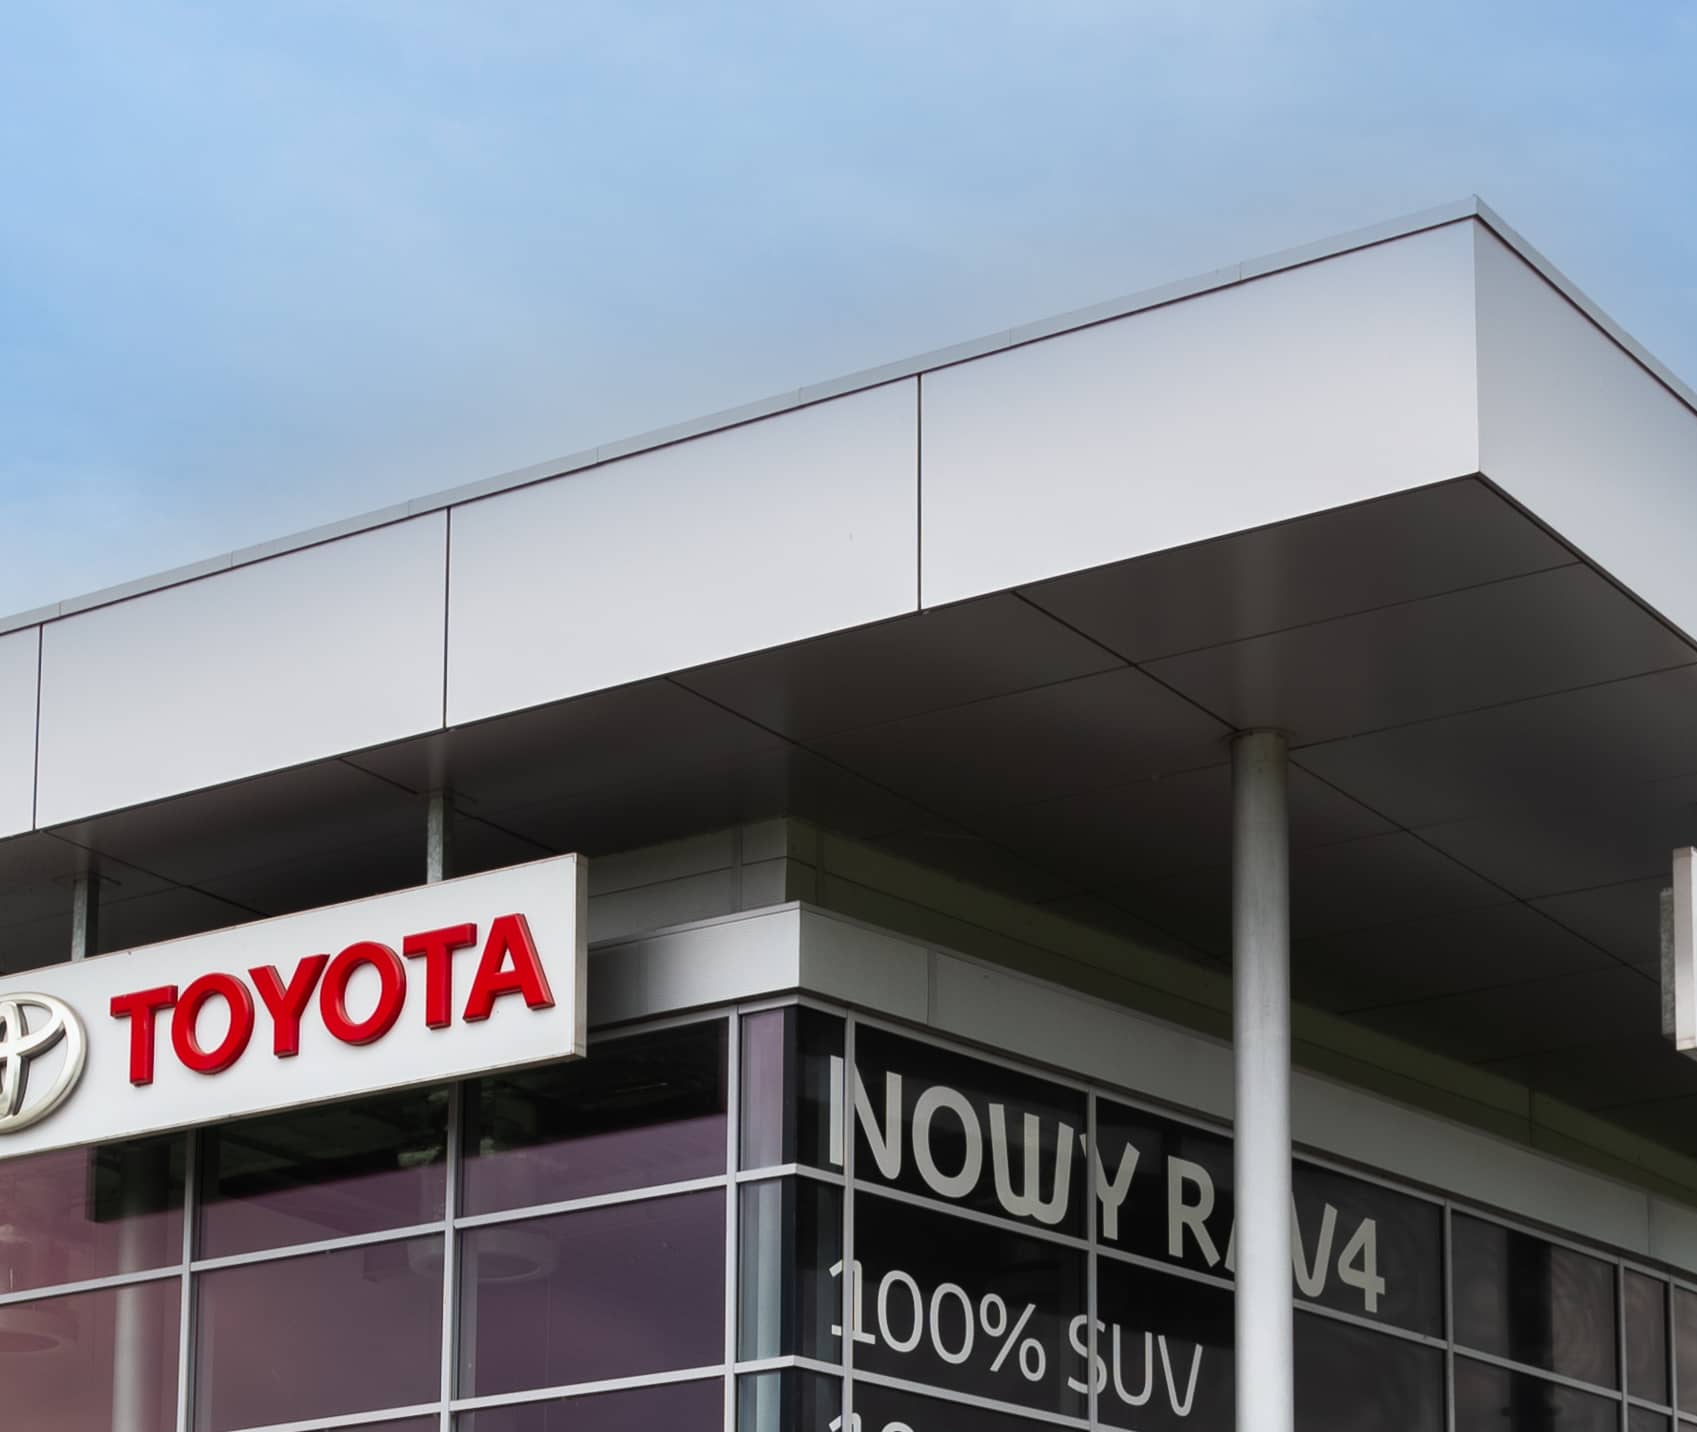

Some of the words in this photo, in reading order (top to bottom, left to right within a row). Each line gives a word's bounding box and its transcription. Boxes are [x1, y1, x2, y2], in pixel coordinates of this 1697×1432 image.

[110, 913, 555, 1087] TOYOTA
[829, 1055, 1140, 1240] NOWY
[1168, 1155, 1385, 1313] RV4
[827, 1258, 1046, 1382] 100%
[1067, 1313, 1203, 1417] SUV
